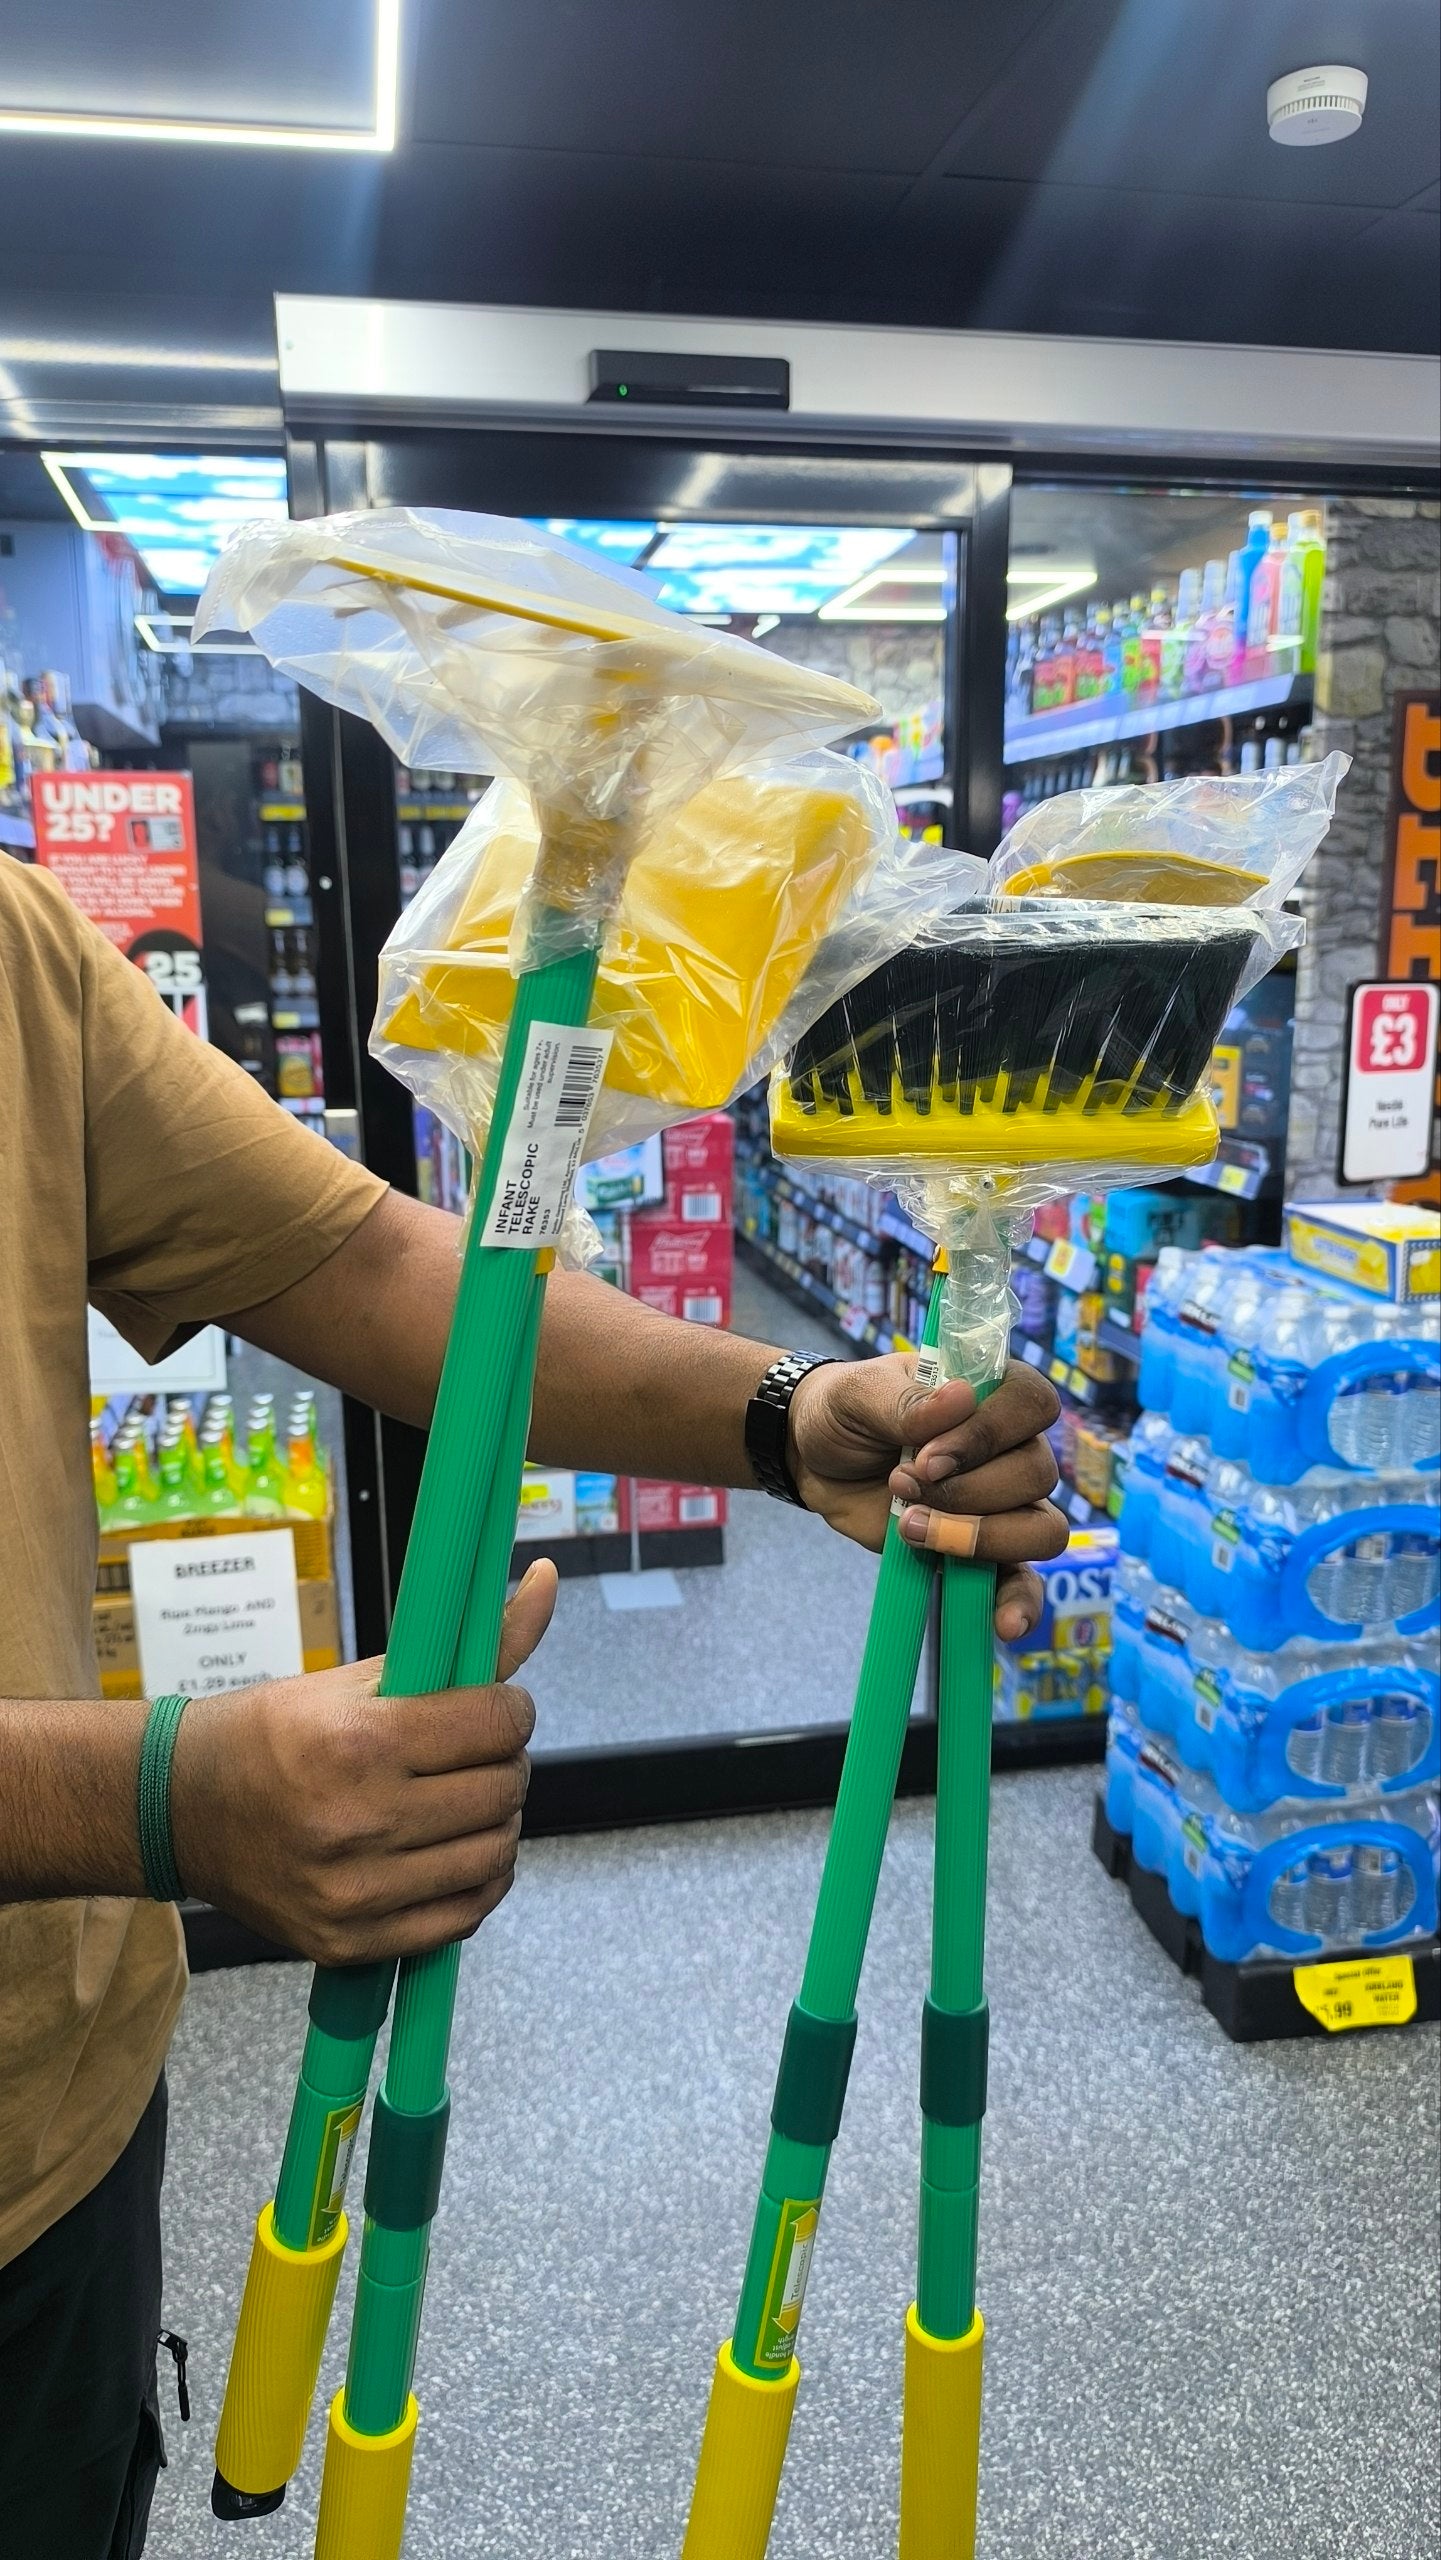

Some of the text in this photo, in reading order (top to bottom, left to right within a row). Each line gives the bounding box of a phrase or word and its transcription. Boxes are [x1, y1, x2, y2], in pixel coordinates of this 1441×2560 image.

[42, 783, 182, 814] UNDER
[46, 813, 115, 842] 25?
[146, 952, 203, 986] 25
[1370, 1012, 1418, 1066] £3
[527, 1040, 552, 1129] Must be used under adult
[529, 1071, 537, 1081] for
[495, 1179, 516, 1233] INFANT
[508, 1143, 538, 1235] TELESCOPIC
[522, 1196, 541, 1235] RAKE
[539, 1209, 551, 1236] 76353
[175, 1557, 255, 1579] BREEZER
[1046, 1567, 1117, 1607] OST
[199, 1651, 248, 1670] ONLY
[791, 2244, 808, 2301] Telescopic
